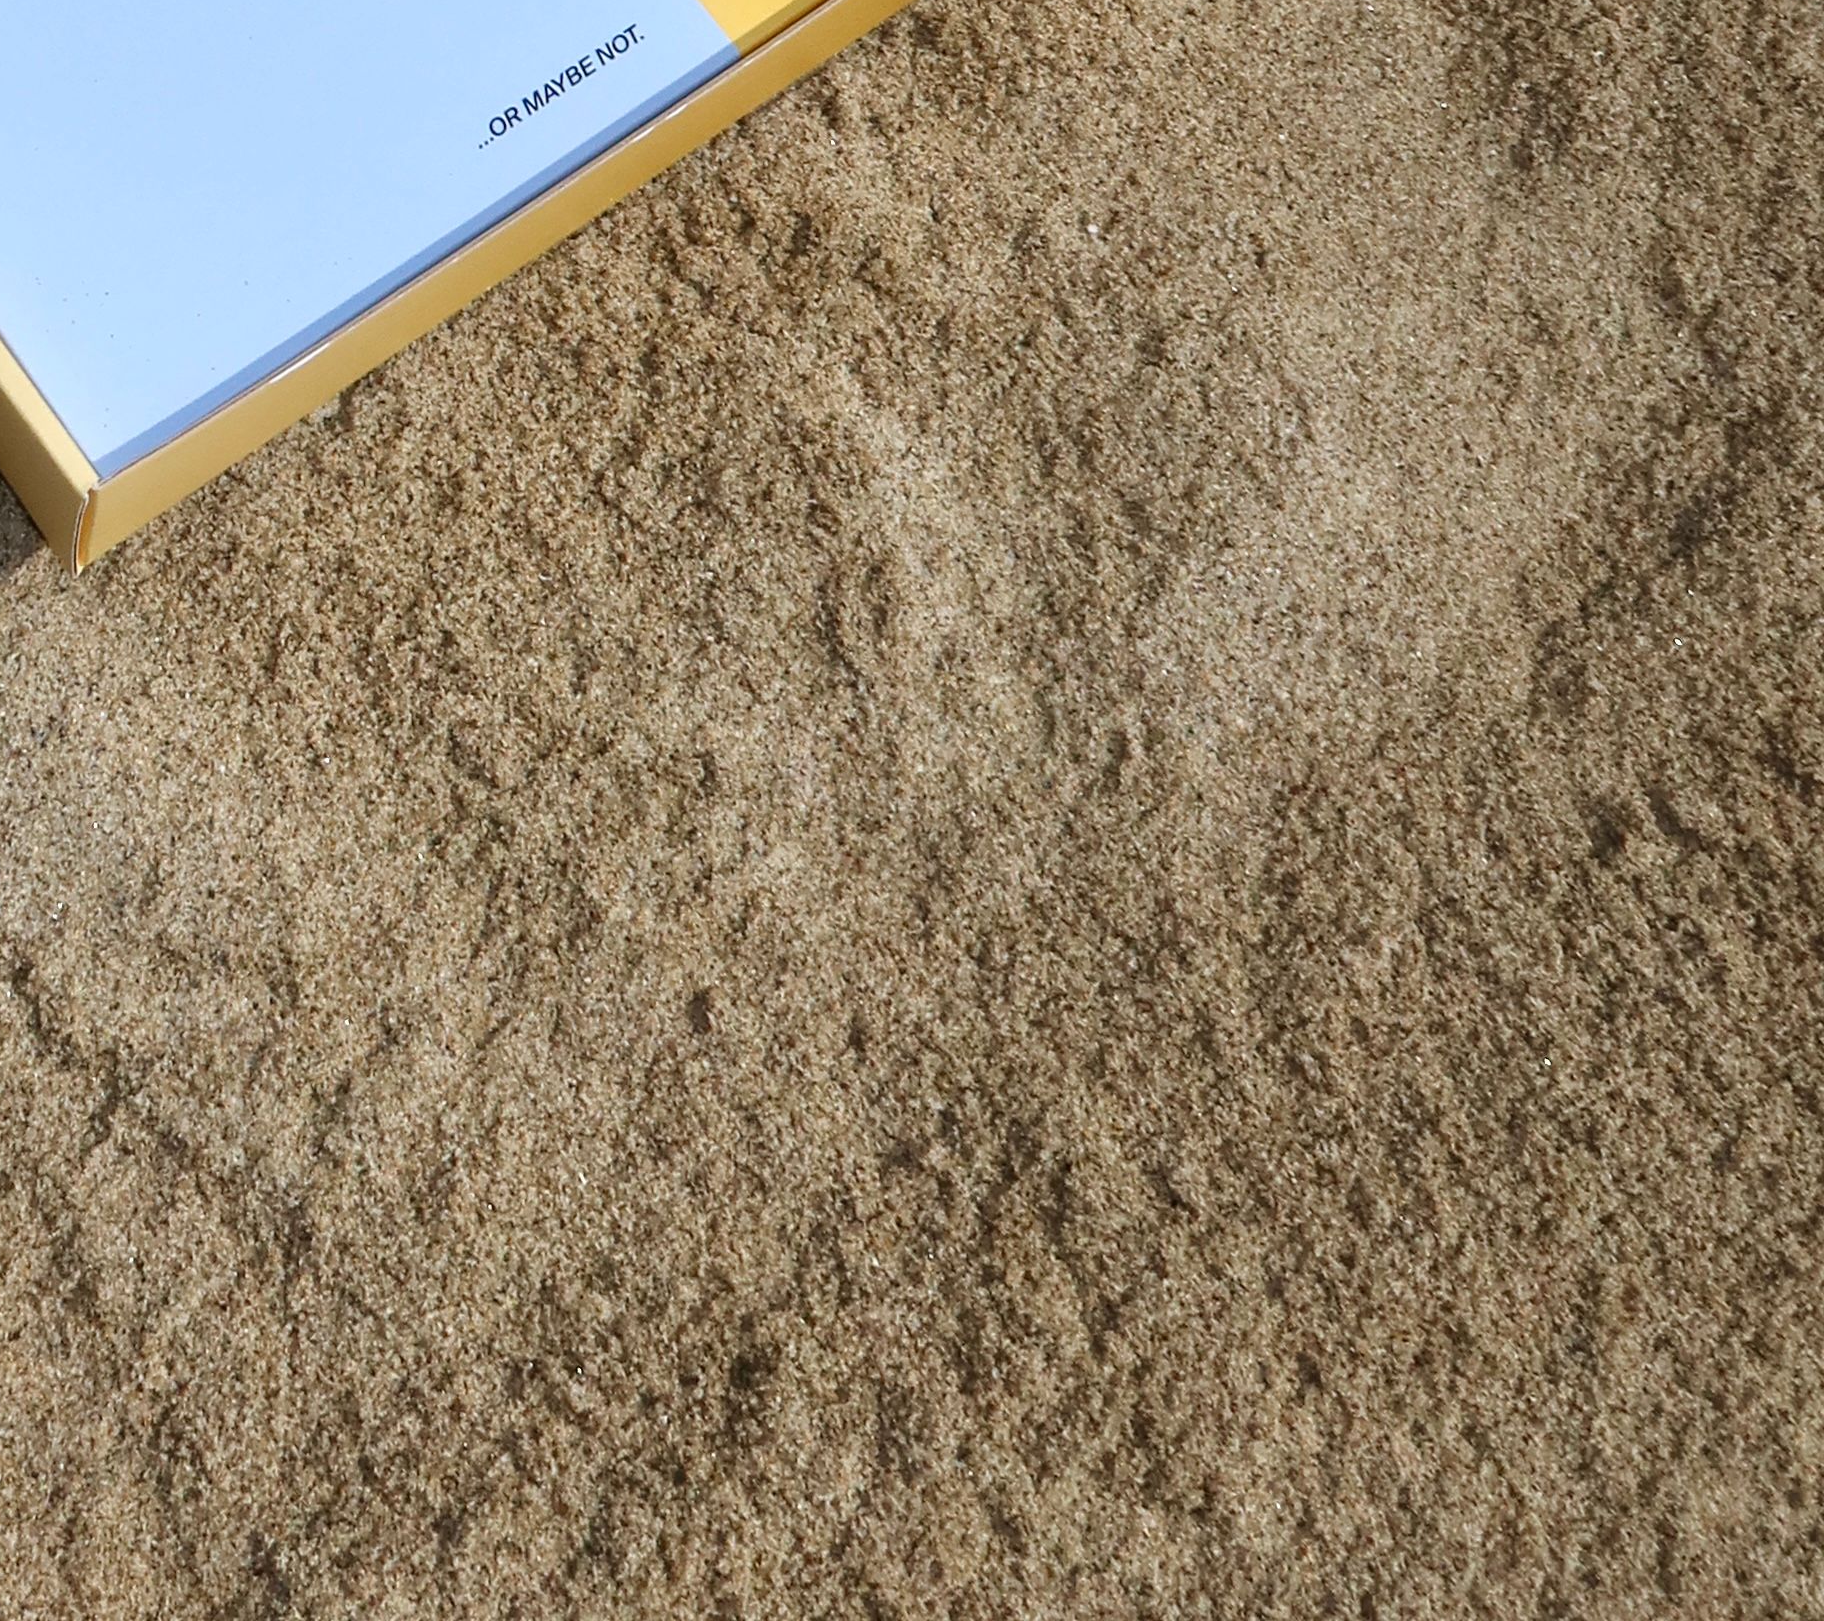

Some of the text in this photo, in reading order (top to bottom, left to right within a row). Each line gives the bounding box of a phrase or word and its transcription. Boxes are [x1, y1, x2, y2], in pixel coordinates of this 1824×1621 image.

[478, 23, 645, 149] ...OR MAYBE NOT.
